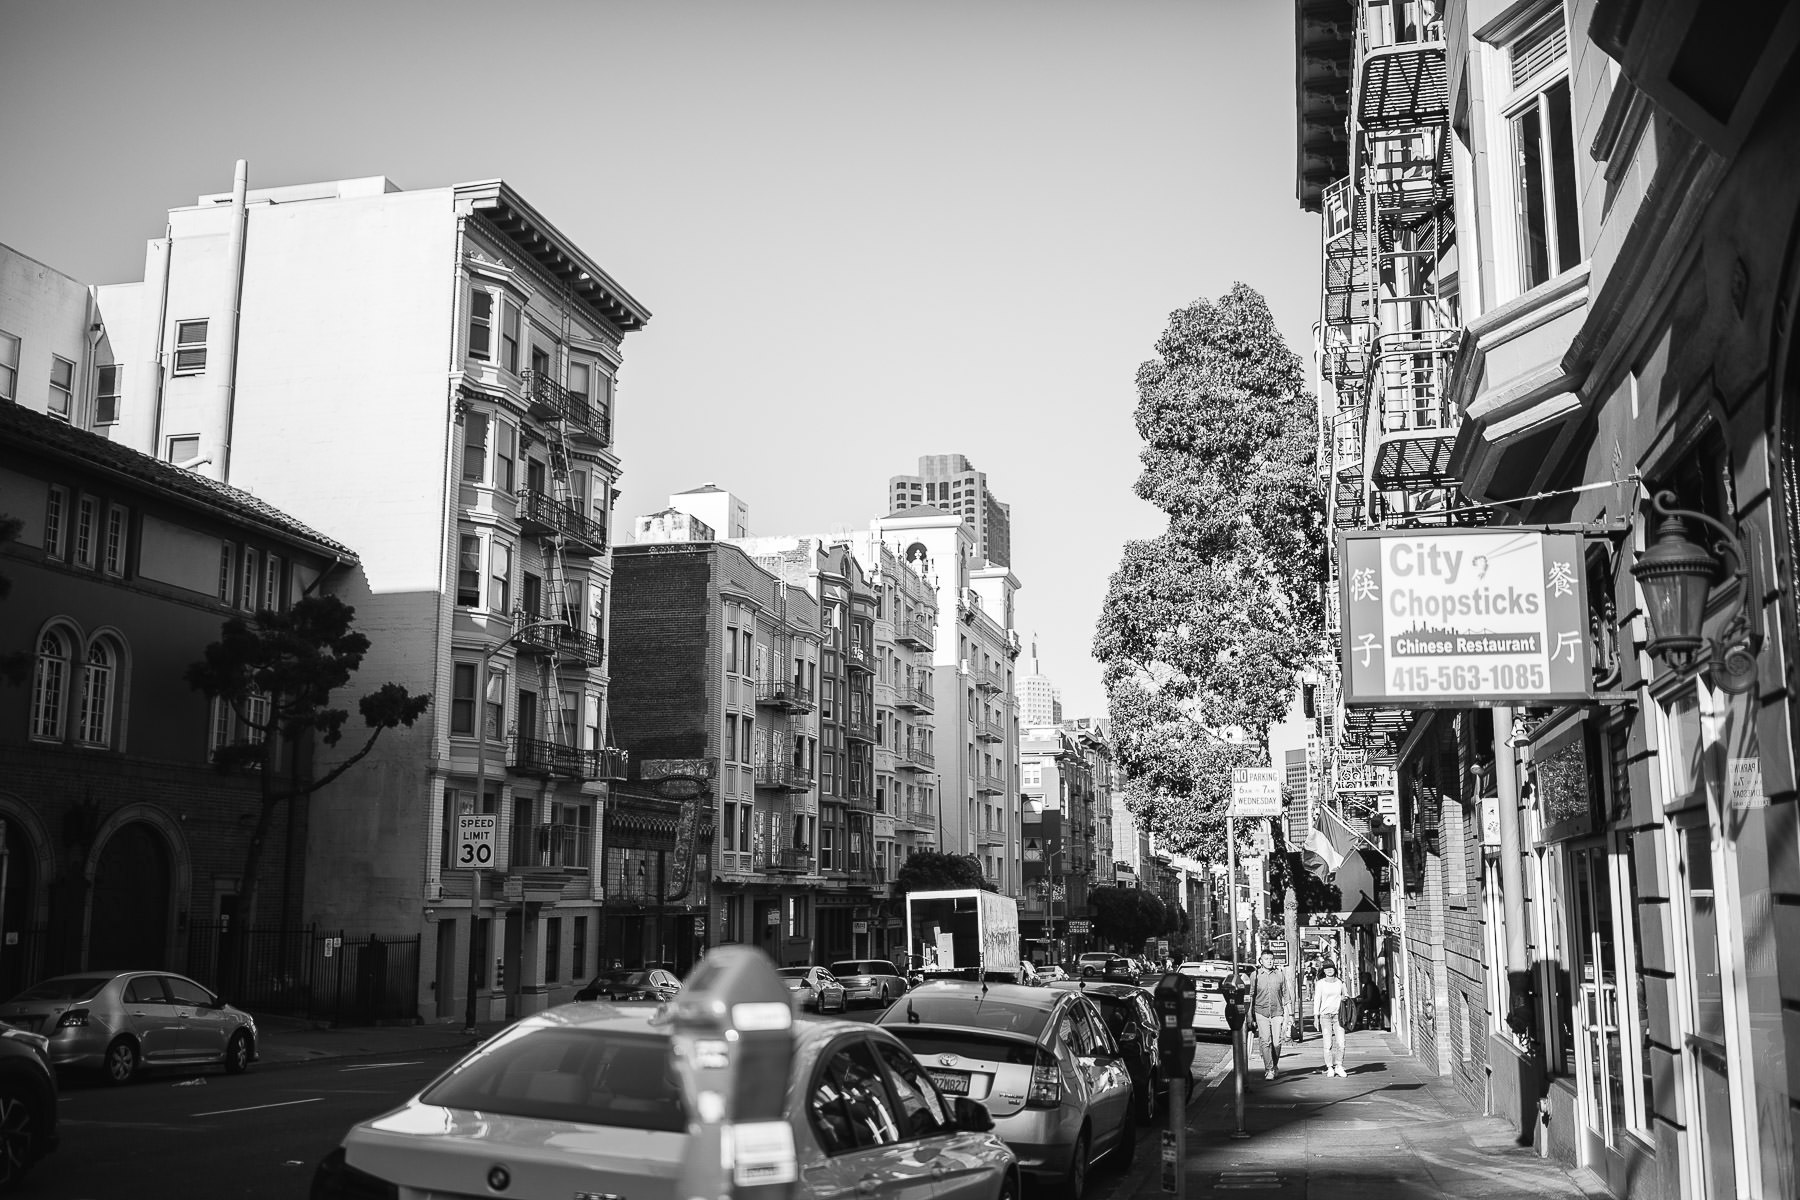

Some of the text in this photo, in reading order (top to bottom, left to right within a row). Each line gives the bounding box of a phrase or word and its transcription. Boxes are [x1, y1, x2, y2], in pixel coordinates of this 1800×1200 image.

[1389, 543, 1463, 584] City
[1390, 586, 1539, 623] Chopsticks
[1396, 635, 1535, 654] Chinese Restaurant
[1392, 664, 1544, 692] 415-563-1085
[1234, 770, 1278, 782] NO PARKING
[1238, 797, 1277, 805] WEDNESDAY
[460, 819, 494, 828] SPEED
[463, 831, 490, 840] LIMIT
[460, 843, 491, 863] 30
